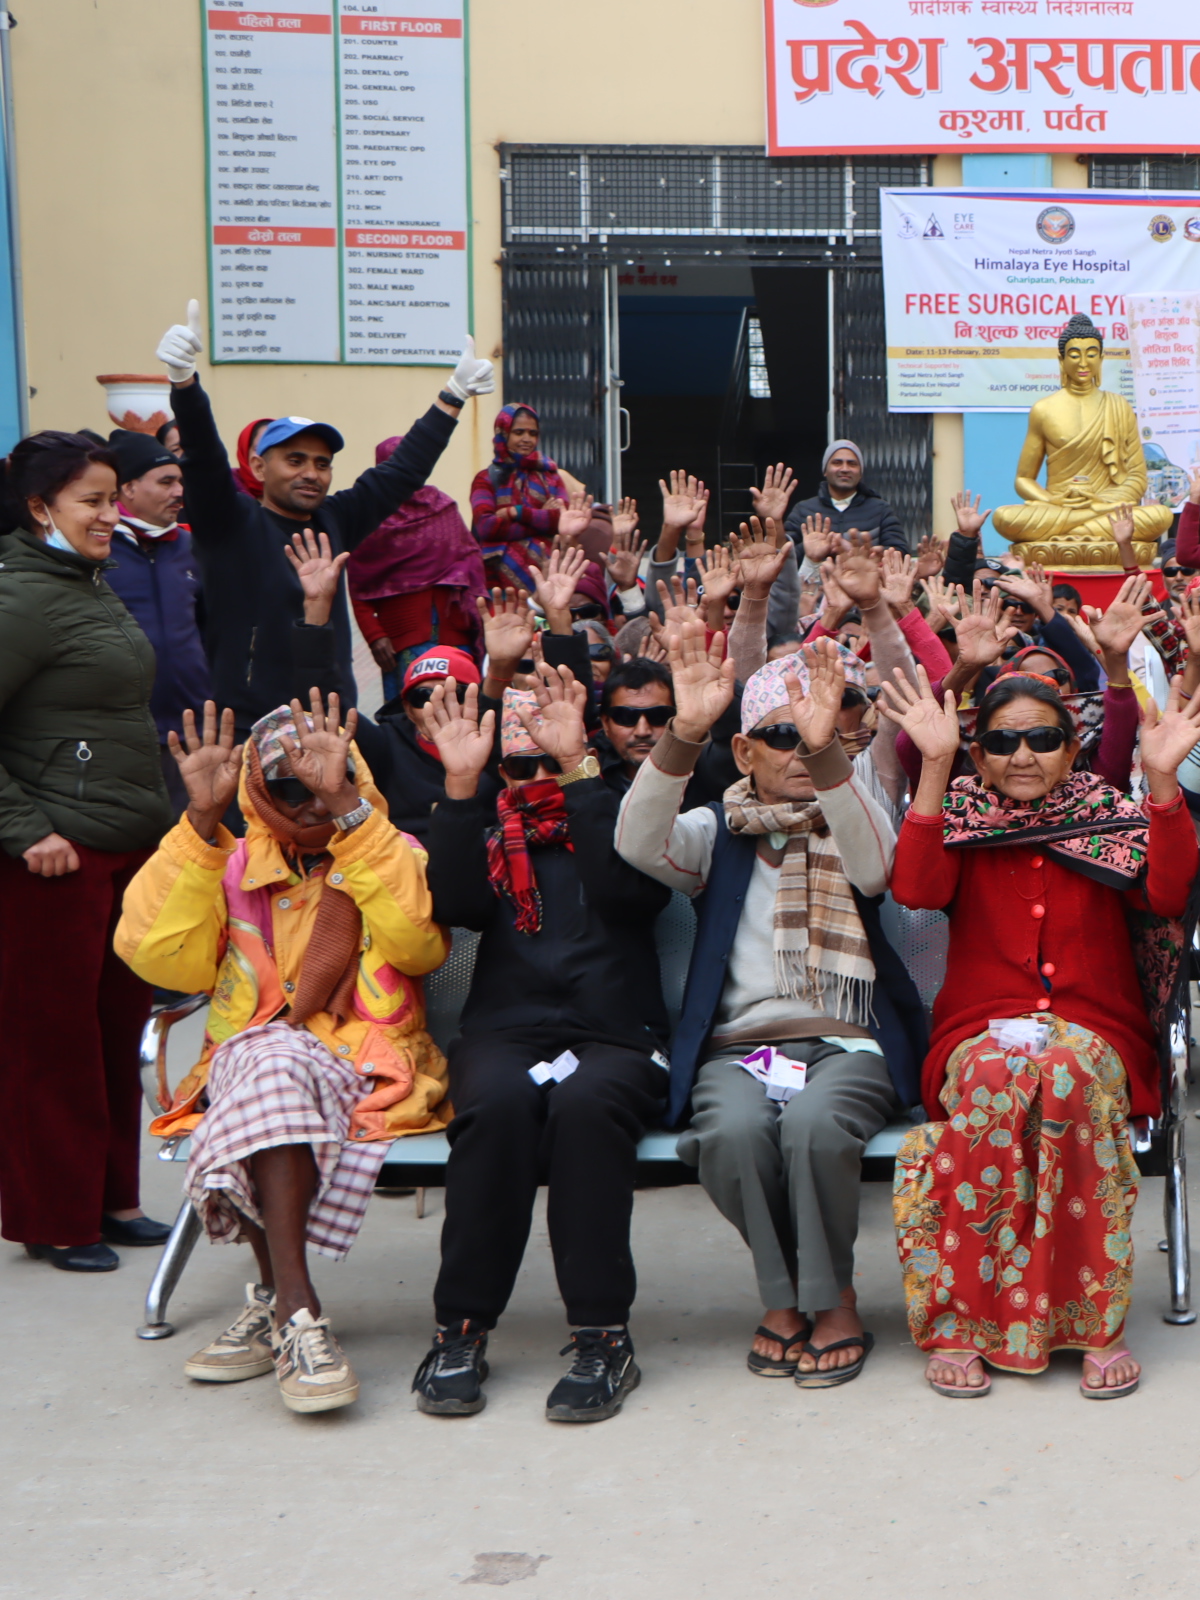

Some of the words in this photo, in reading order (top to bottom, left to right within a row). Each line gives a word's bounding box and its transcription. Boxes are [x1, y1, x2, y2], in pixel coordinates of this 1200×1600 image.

[238, 14, 274, 27] पहिलो
[278, 18, 301, 28] तला
[360, 20, 397, 31] FIRST
[401, 22, 442, 33] FLOOR
[786, 19, 946, 101] प्रदेश
[938, 108, 1030, 139] कुश्मा,
[1043, 103, 1108, 132] पर्वत
[954, 213, 974, 222] EYE
[277, 233, 301, 242] तला
[357, 234, 408, 245] SECOND
[411, 235, 453, 246] FLOOR
[1008, 248, 1030, 256] Nepal
[1055, 249, 1072, 257] Jyoti
[1075, 249, 1096, 257] Sangh
[974, 258, 1039, 272] Himalaya
[1044, 259, 1068, 272] Eye
[1073, 259, 1130, 273] Hospital
[1007, 276, 1057, 284] Gharipatan,
[1059, 277, 1095, 285] Pokhara
[905, 294, 960, 314] FREE
[968, 294, 1081, 315] SURGICAL
[411, 659, 448, 677] KING
